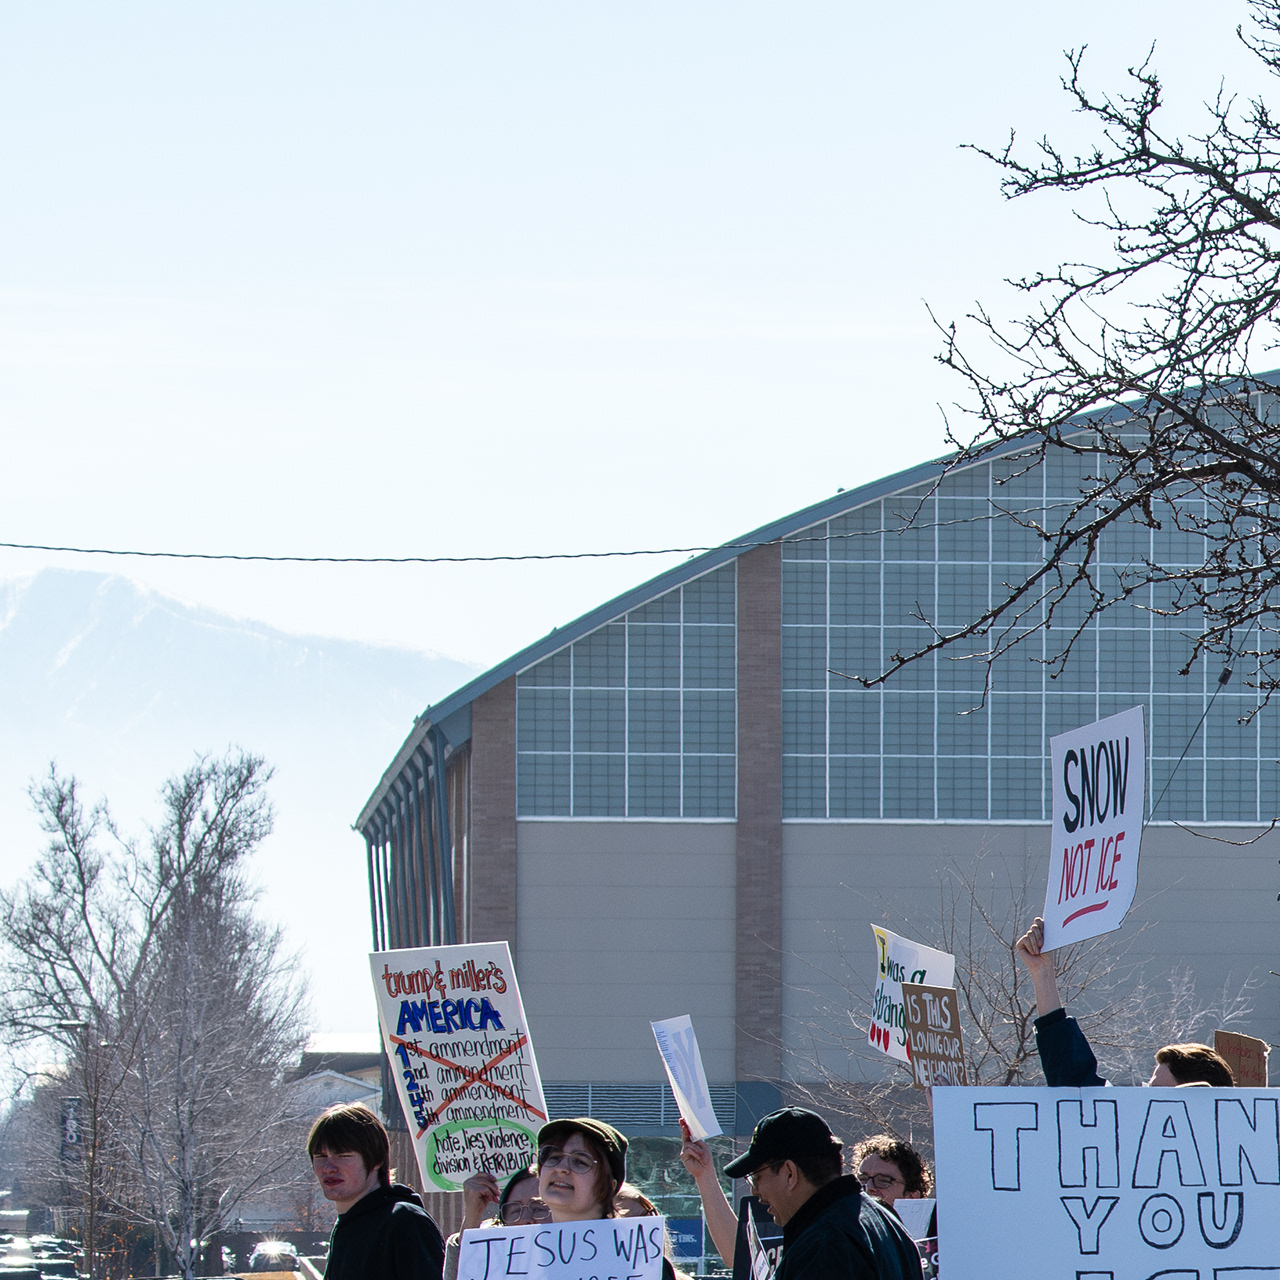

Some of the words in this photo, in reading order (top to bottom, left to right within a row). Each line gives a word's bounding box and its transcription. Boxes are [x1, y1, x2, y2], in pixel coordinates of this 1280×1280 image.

[1063, 736, 1129, 834] SNOW
[1057, 838, 1095, 905] NOT
[1095, 831, 1125, 894] ICE
[382, 963, 433, 1000] trump
[887, 956, 905, 983] was
[396, 997, 506, 1036] AMERICA
[906, 993, 921, 1024] IS
[922, 992, 951, 1030] THIS
[395, 1038, 422, 1069] 1st
[429, 1028, 525, 1060] ammendment
[944, 1038, 962, 1059] OUR
[403, 1062, 428, 1092] 2nd
[437, 1057, 530, 1086] ammendment
[409, 1083, 434, 1112] 4th
[441, 1080, 532, 1104] ammendment
[415, 1105, 439, 1130] 5th
[446, 1103, 536, 1122] ammendment
[432, 1154, 471, 1175] division
[1061, 1191, 1245, 1255] YOU
[613, 1224, 662, 1270] WAS
